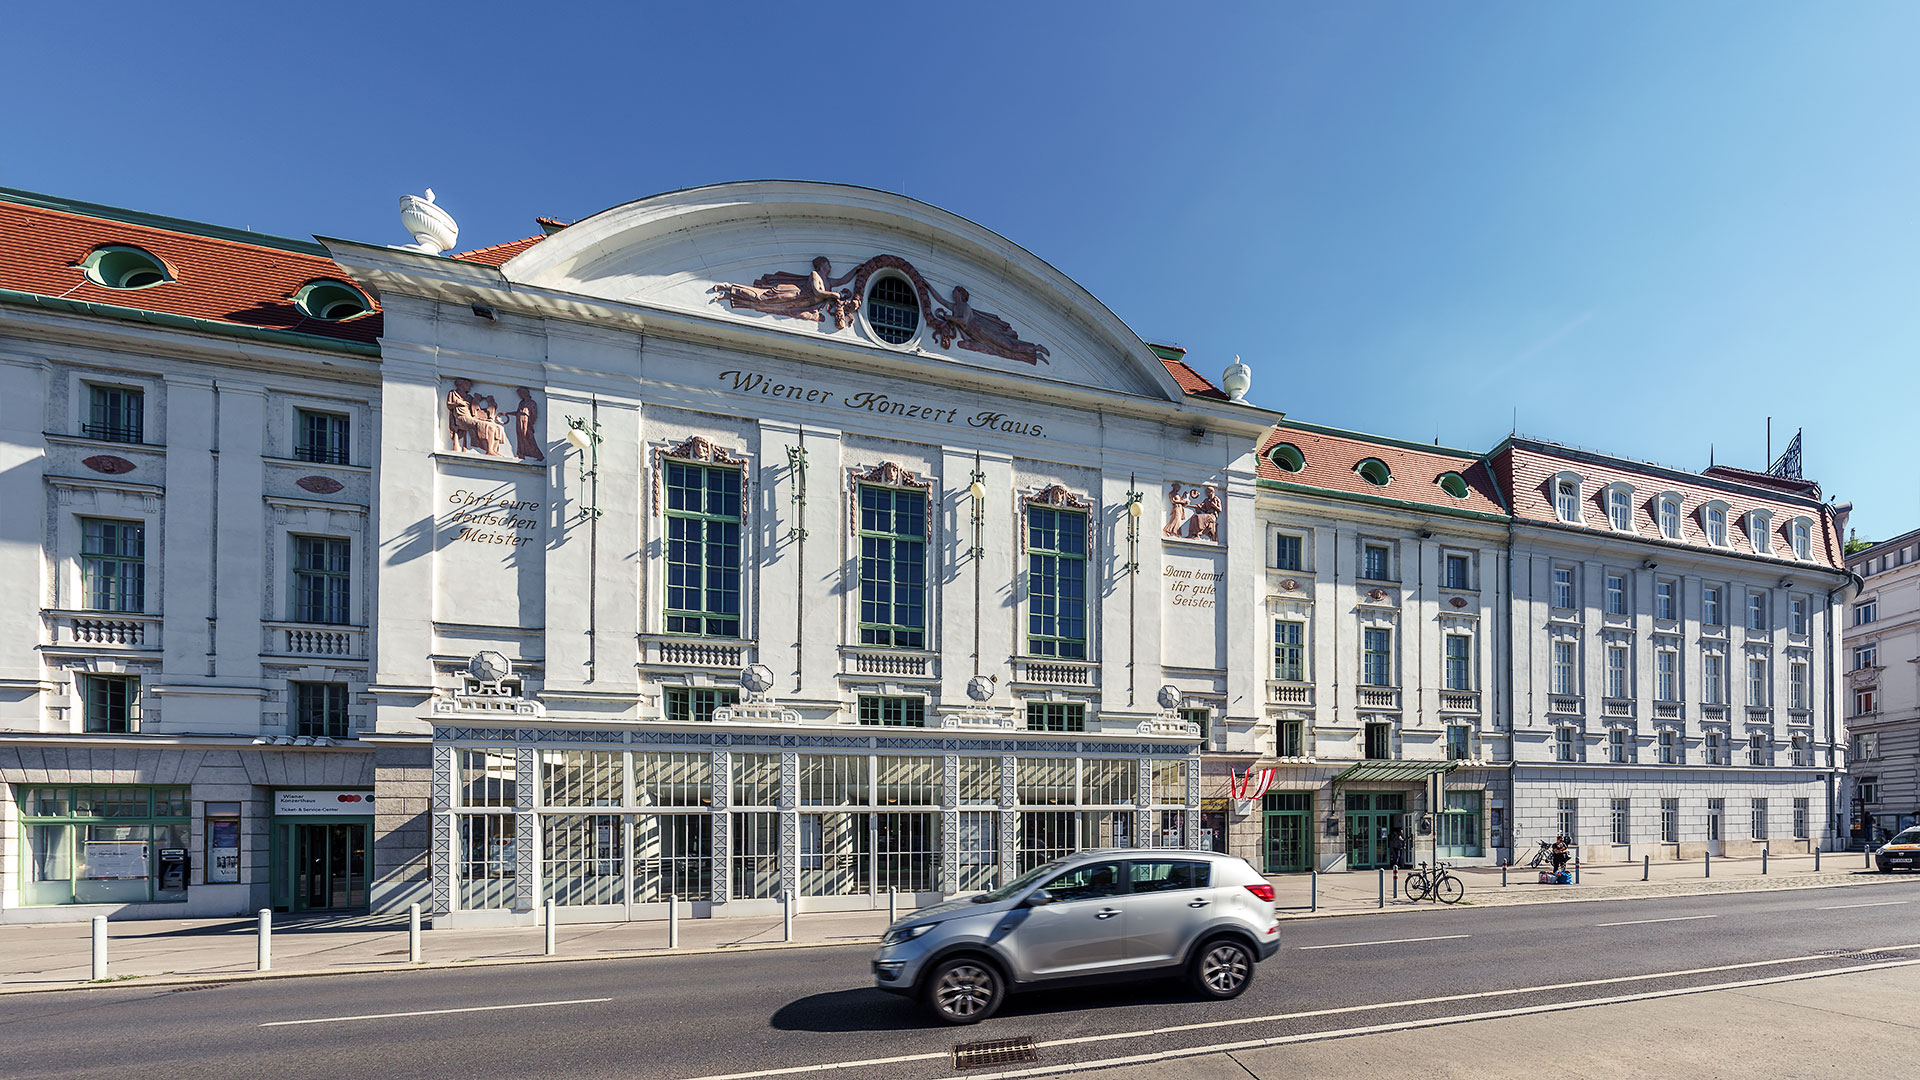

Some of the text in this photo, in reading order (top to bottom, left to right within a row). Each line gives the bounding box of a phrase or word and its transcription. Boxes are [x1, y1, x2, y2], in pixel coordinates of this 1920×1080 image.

[718, 370, 834, 404] Wiener
[844, 391, 957, 423] Konzert
[449, 489, 539, 511] Ehrt eure
[451, 510, 537, 529] deutschen
[450, 527, 533, 547] Meister
[1163, 565, 1224, 582] Dann bannt
[1171, 581, 1216, 596] ihr gute
